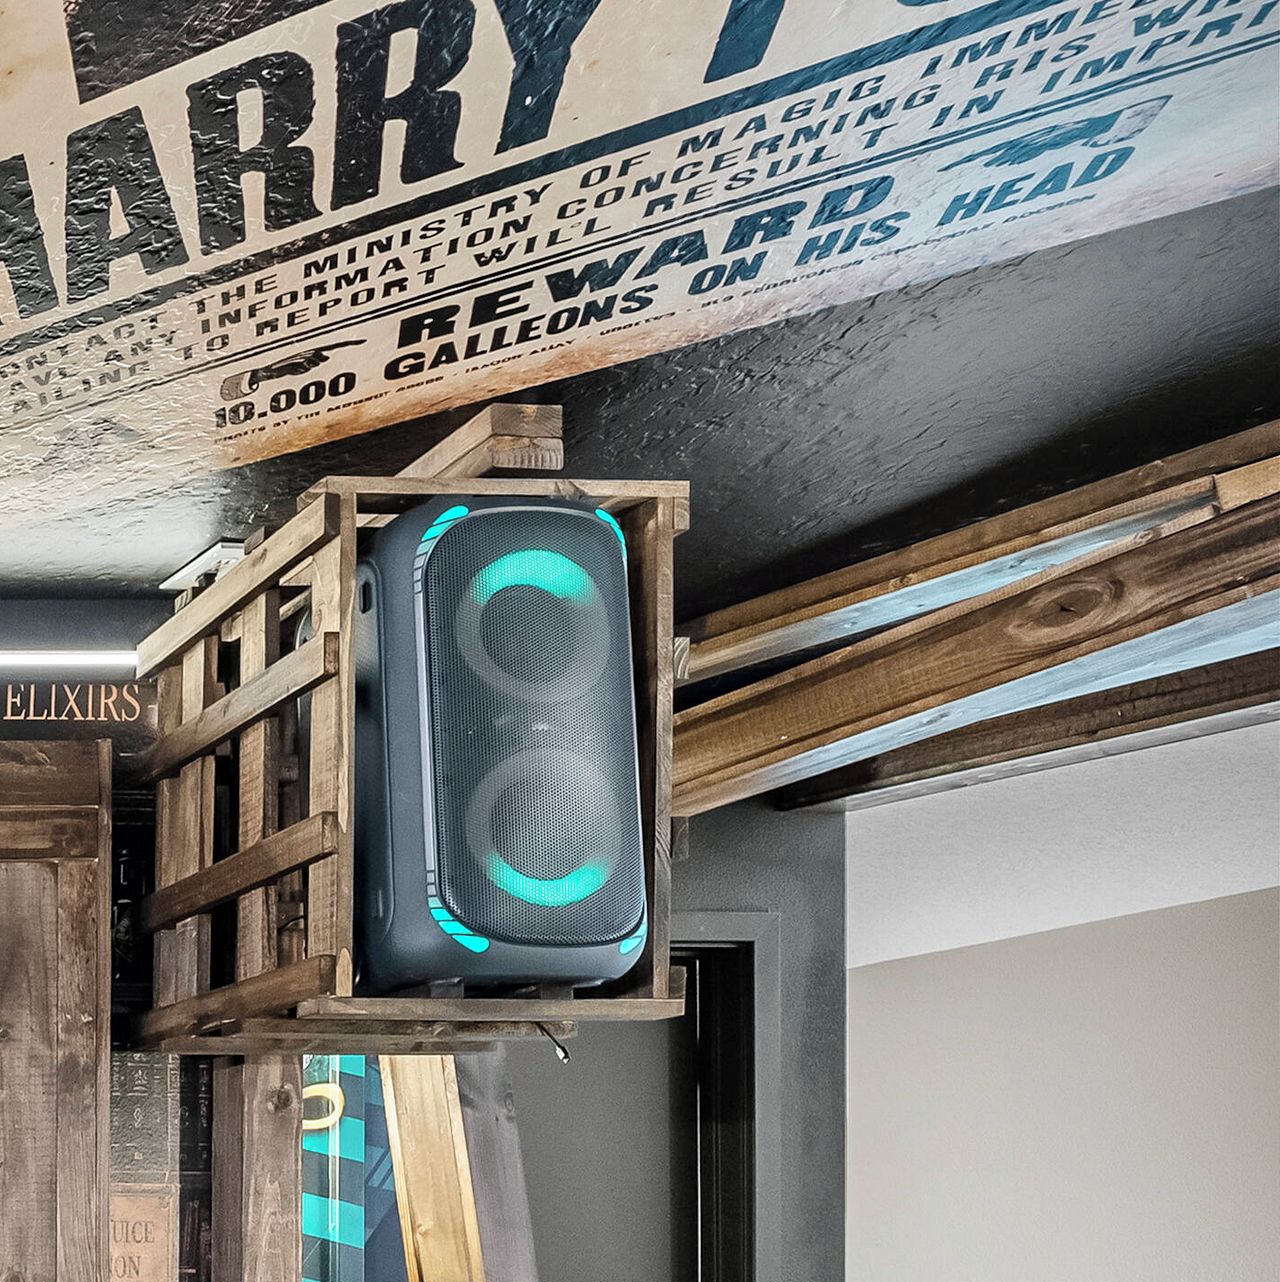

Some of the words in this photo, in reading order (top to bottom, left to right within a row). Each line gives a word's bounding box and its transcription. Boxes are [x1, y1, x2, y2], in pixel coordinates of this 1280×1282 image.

[171, 334, 230, 361] TO
[255, 264, 446, 338] REPORT
[473, 216, 612, 268] WILL
[929, 88, 1006, 130] IN
[189, 273, 278, 315] THE
[303, 183, 555, 279] MINISTRY
[580, 151, 651, 190] OF
[201, 212, 533, 334] INFORMATION
[556, 84, 943, 220] CONCERNING
[383, 283, 659, 381] GALLEONS
[688, 251, 769, 296] ON
[793, 210, 912, 267] HIS
[934, 146, 1136, 229] HEAD
[397, 174, 895, 349] REWARD
[2, 683, 141, 723] ELIXIRS
